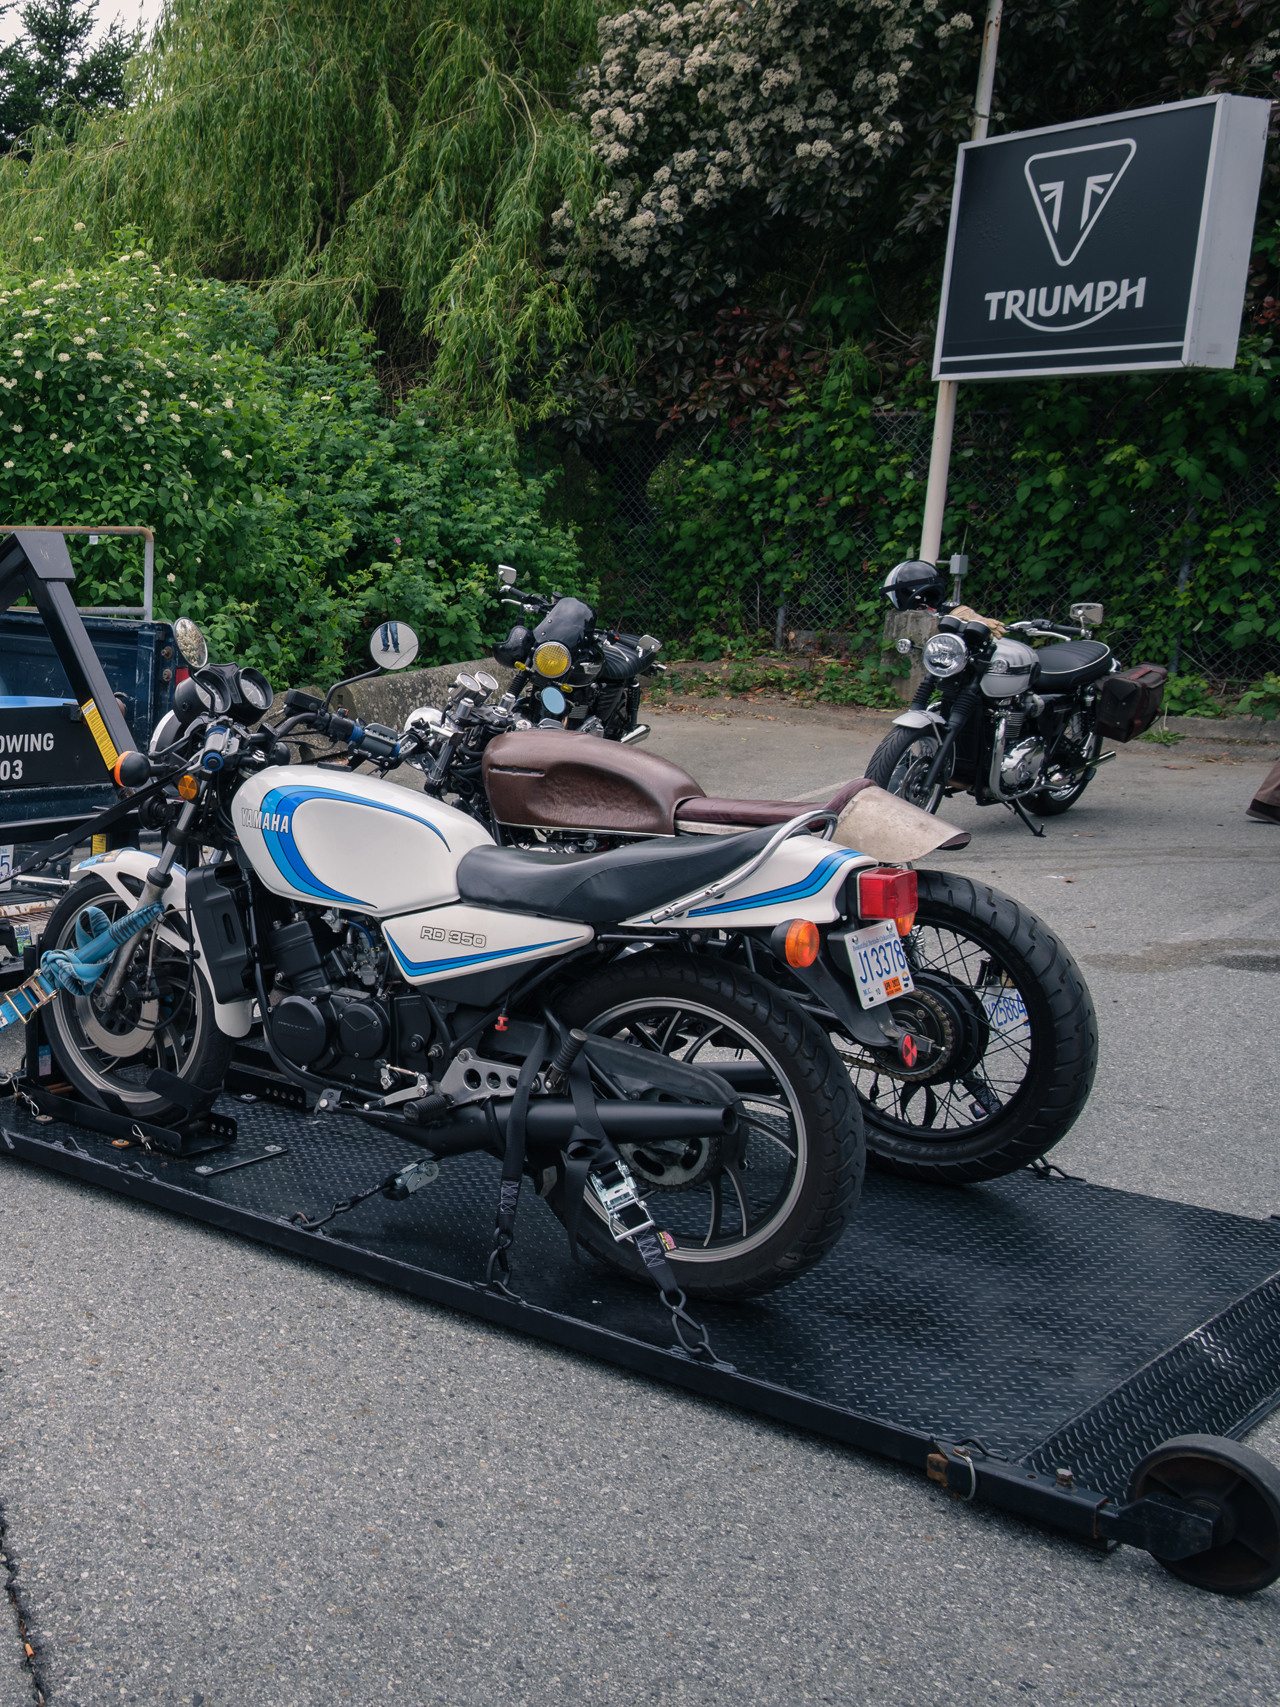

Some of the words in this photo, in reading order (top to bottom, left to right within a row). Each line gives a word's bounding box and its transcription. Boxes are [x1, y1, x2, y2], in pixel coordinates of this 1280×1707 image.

[984, 276, 1146, 331] TRIUMPH
[241, 807, 289, 833] YAMAHA
[420, 926, 445, 941] RD
[449, 930, 487, 948] 350
[858, 939, 906, 984] J13378
